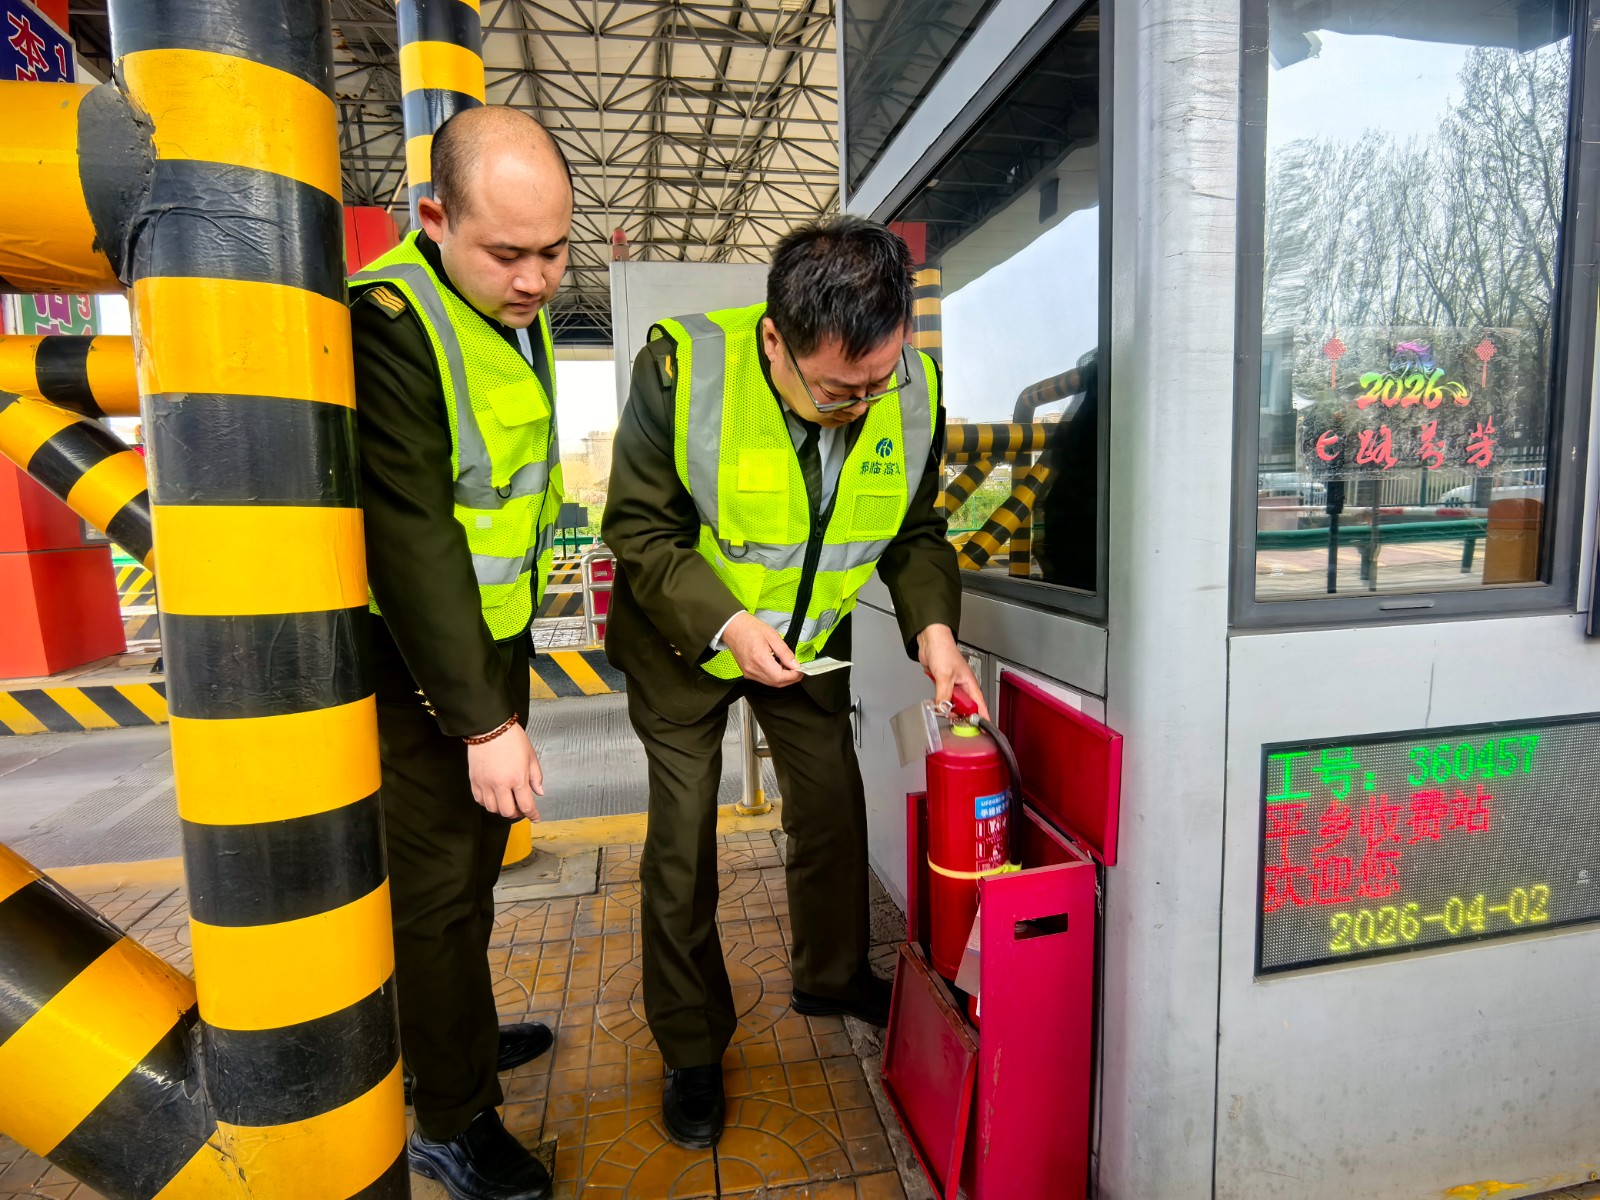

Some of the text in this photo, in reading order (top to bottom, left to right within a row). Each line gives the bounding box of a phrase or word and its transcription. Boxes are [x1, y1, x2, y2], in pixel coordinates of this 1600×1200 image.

[1356, 367, 1446, 410] 2026
[1407, 735, 1540, 786] 360457
[1265, 784, 1493, 867] 平乡收费站
[1264, 850, 1402, 912] 欢迎您
[1329, 885, 1551, 951] 2026-04-02
